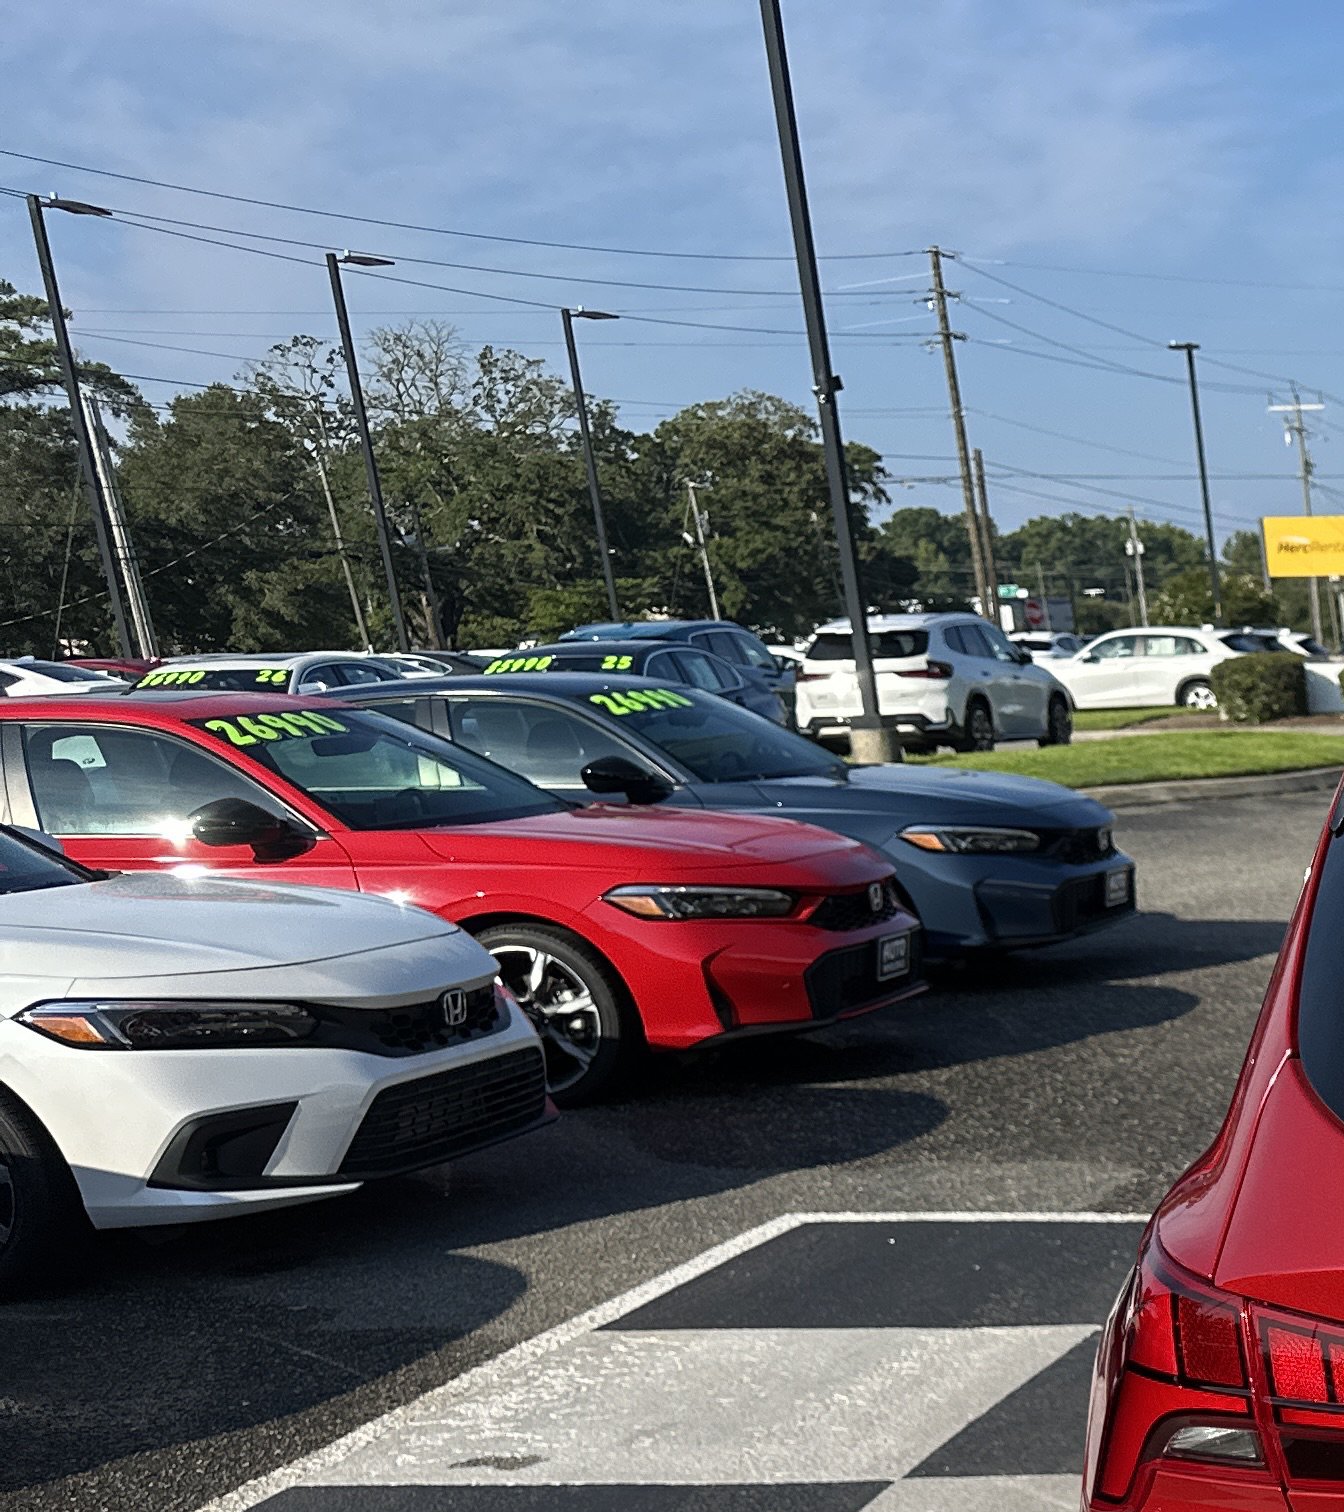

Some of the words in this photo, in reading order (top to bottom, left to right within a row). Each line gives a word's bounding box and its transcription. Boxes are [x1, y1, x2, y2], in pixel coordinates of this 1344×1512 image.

[602, 655, 633, 670] 25
[256, 669, 287, 683] 26
[204, 711, 349, 746] 26990
